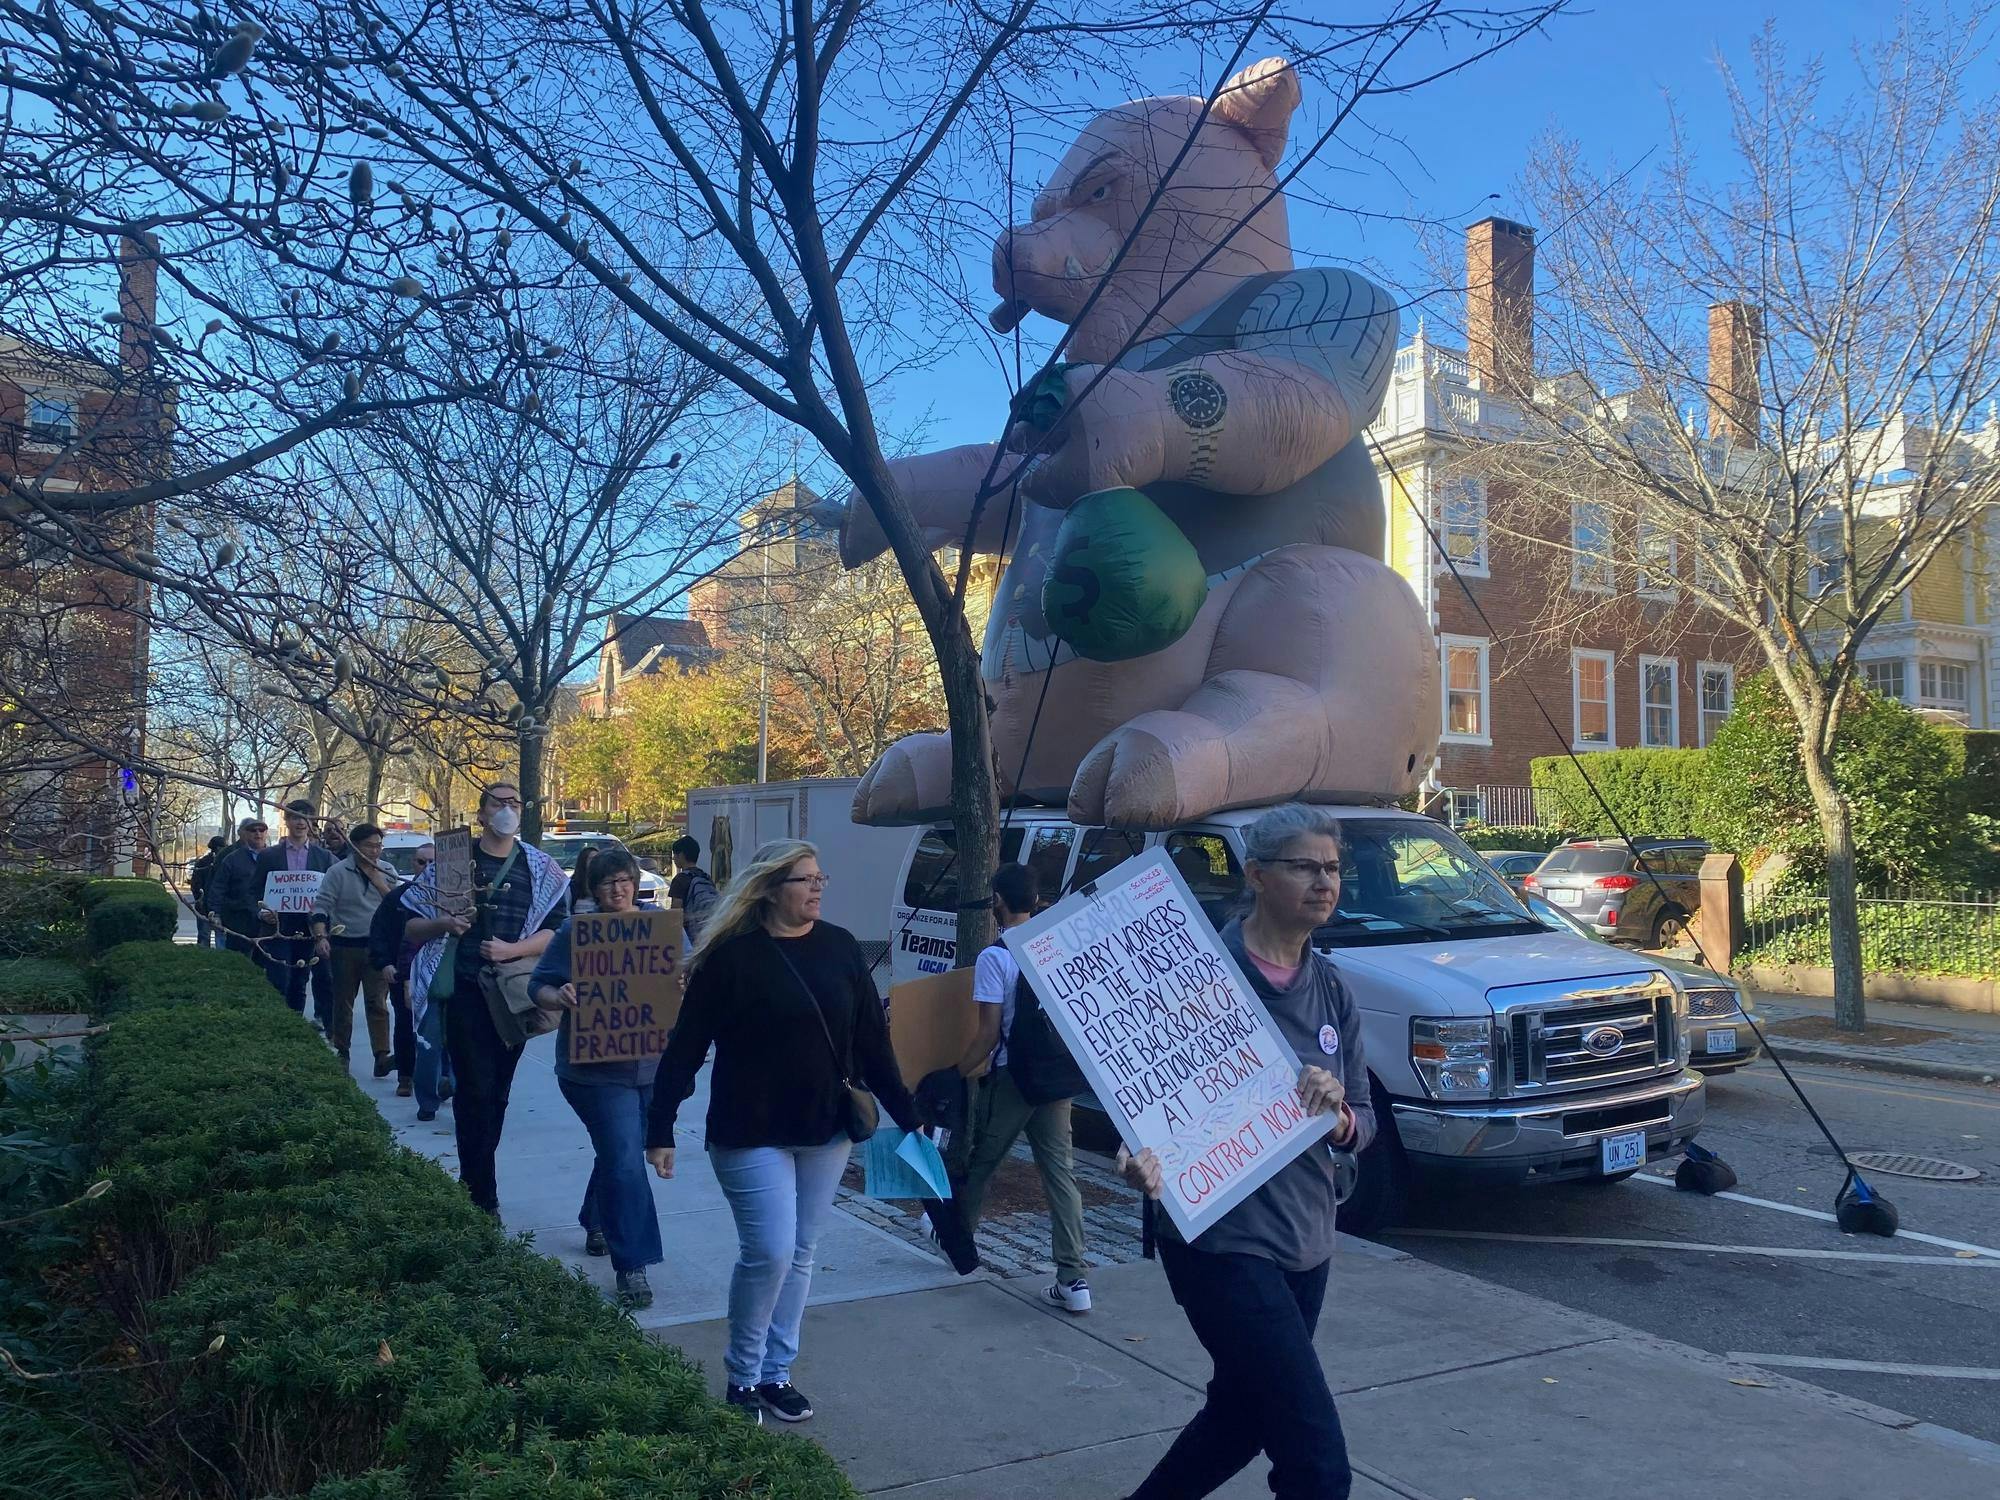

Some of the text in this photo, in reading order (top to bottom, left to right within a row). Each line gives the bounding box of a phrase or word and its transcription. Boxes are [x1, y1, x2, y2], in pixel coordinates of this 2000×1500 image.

[274, 874, 317, 884] WORKERS
[576, 917, 652, 946] BROWN
[929, 915, 943, 925] FOR
[900, 928, 957, 960] Teams
[1047, 899, 1187, 1000] LIBRARY WORKERS
[576, 945, 675, 977] VIOLATES
[1067, 928, 1199, 1026] DO THE UNSEEN
[576, 979, 628, 1008] FAIR
[576, 1004, 656, 1032] LABOR
[1084, 982, 1169, 1056] EVERYDAY
[1100, 977, 1238, 1085] THE BACKBONE OF
[576, 1029, 668, 1060] PRACTICE
[1599, 1034, 1616, 1047] Ford
[1162, 1089, 1193, 1135] AT
[1194, 1042, 1263, 1103] BROWN
[1179, 1121, 1264, 1203] CONTRACT
[1609, 1142, 1641, 1162] UN 251
